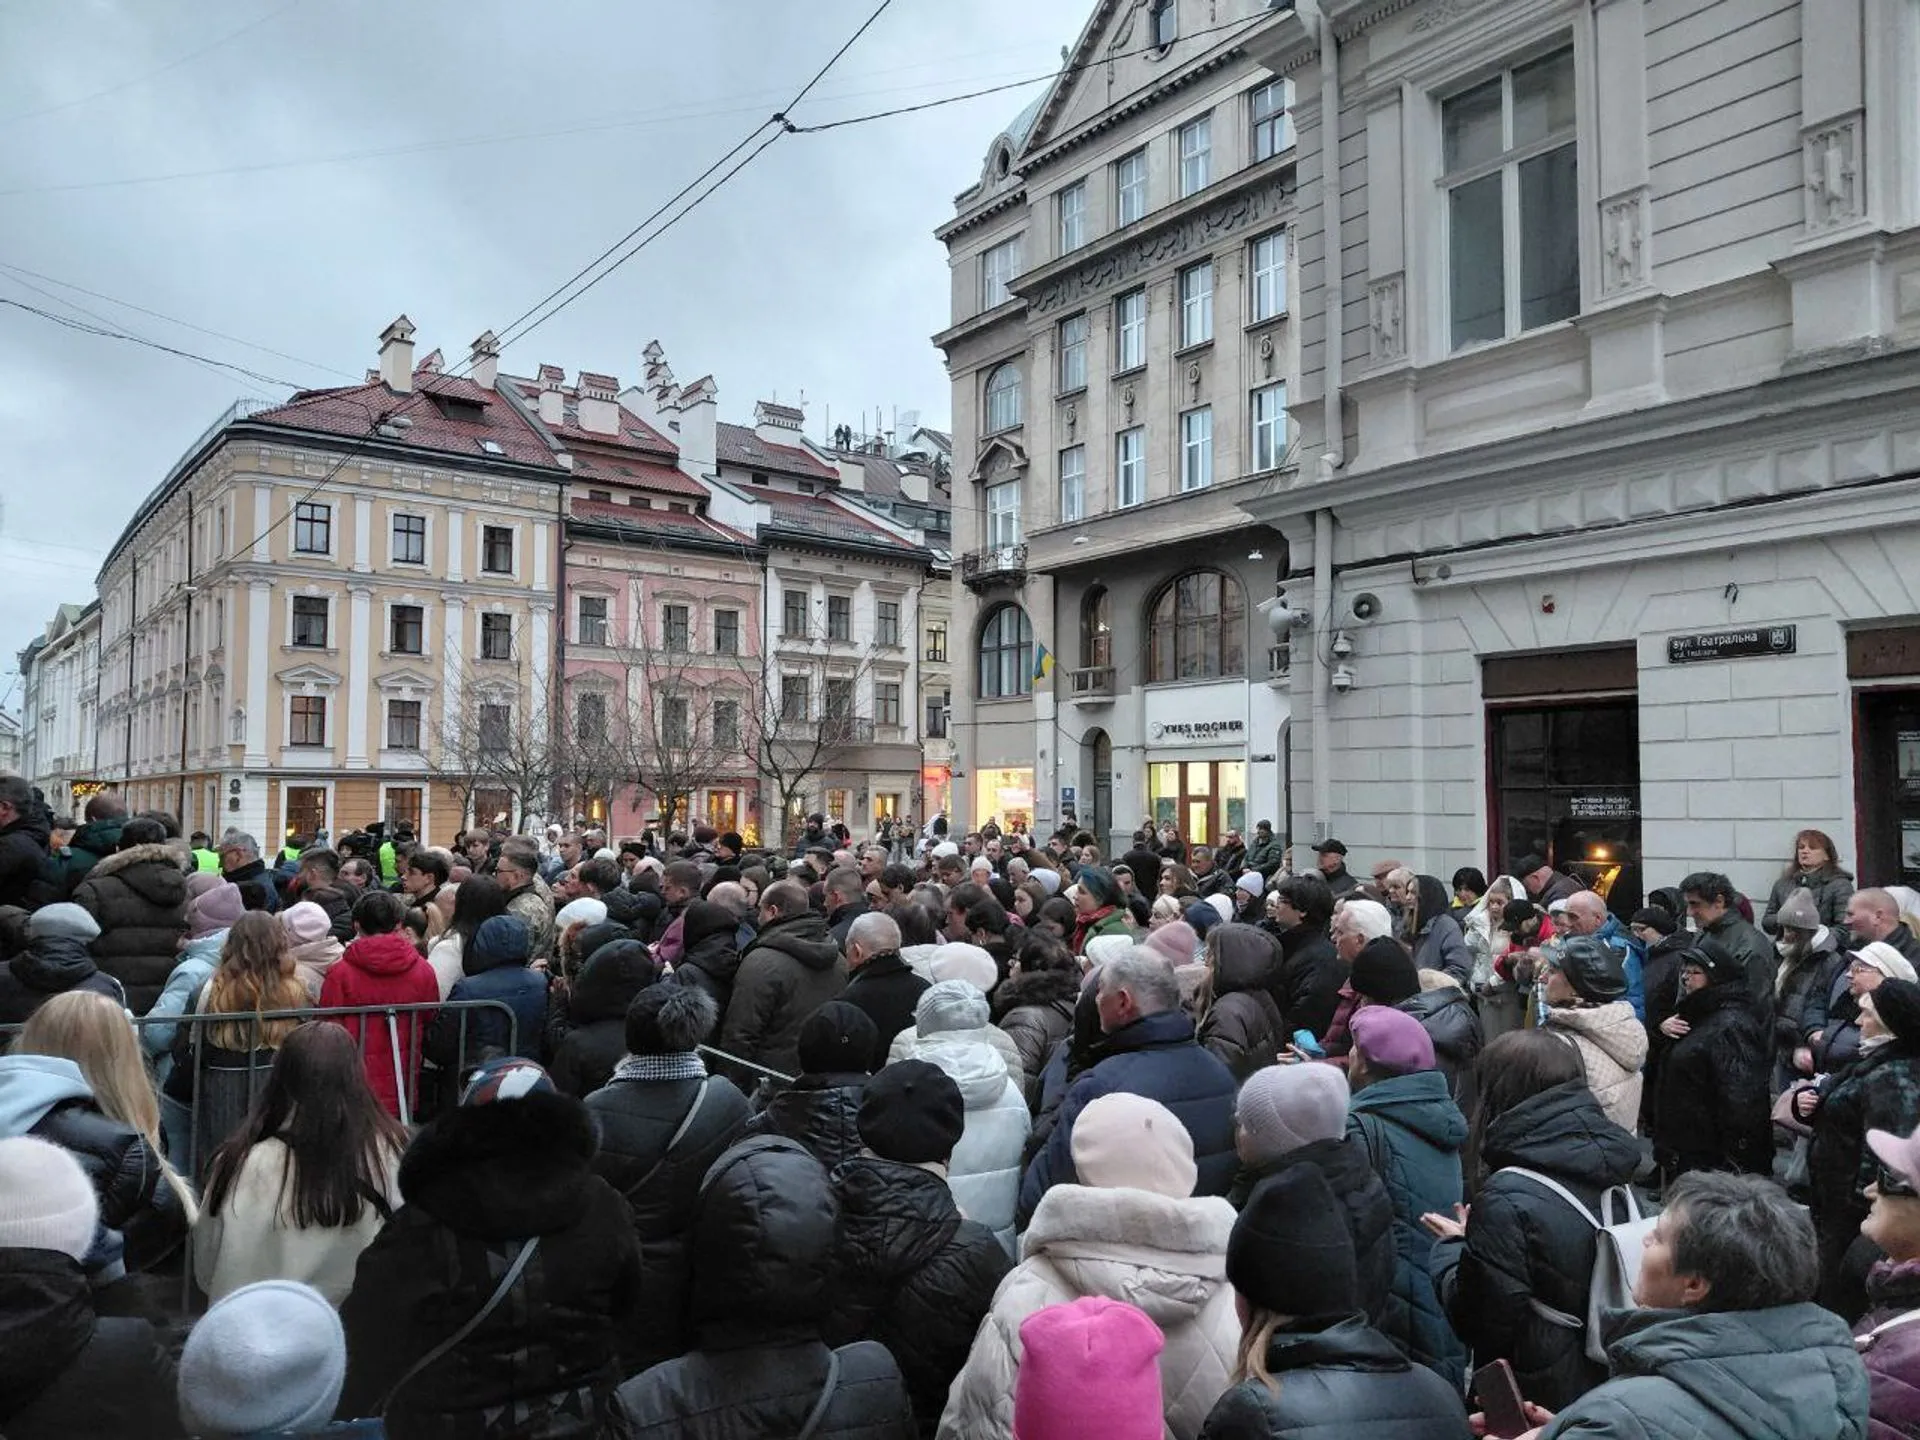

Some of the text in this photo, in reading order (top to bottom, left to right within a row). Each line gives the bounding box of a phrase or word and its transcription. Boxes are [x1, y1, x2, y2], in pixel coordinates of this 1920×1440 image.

[1673, 633, 1758, 650] вул. Театральна
[1164, 721, 1243, 734] YVES ROCHER
